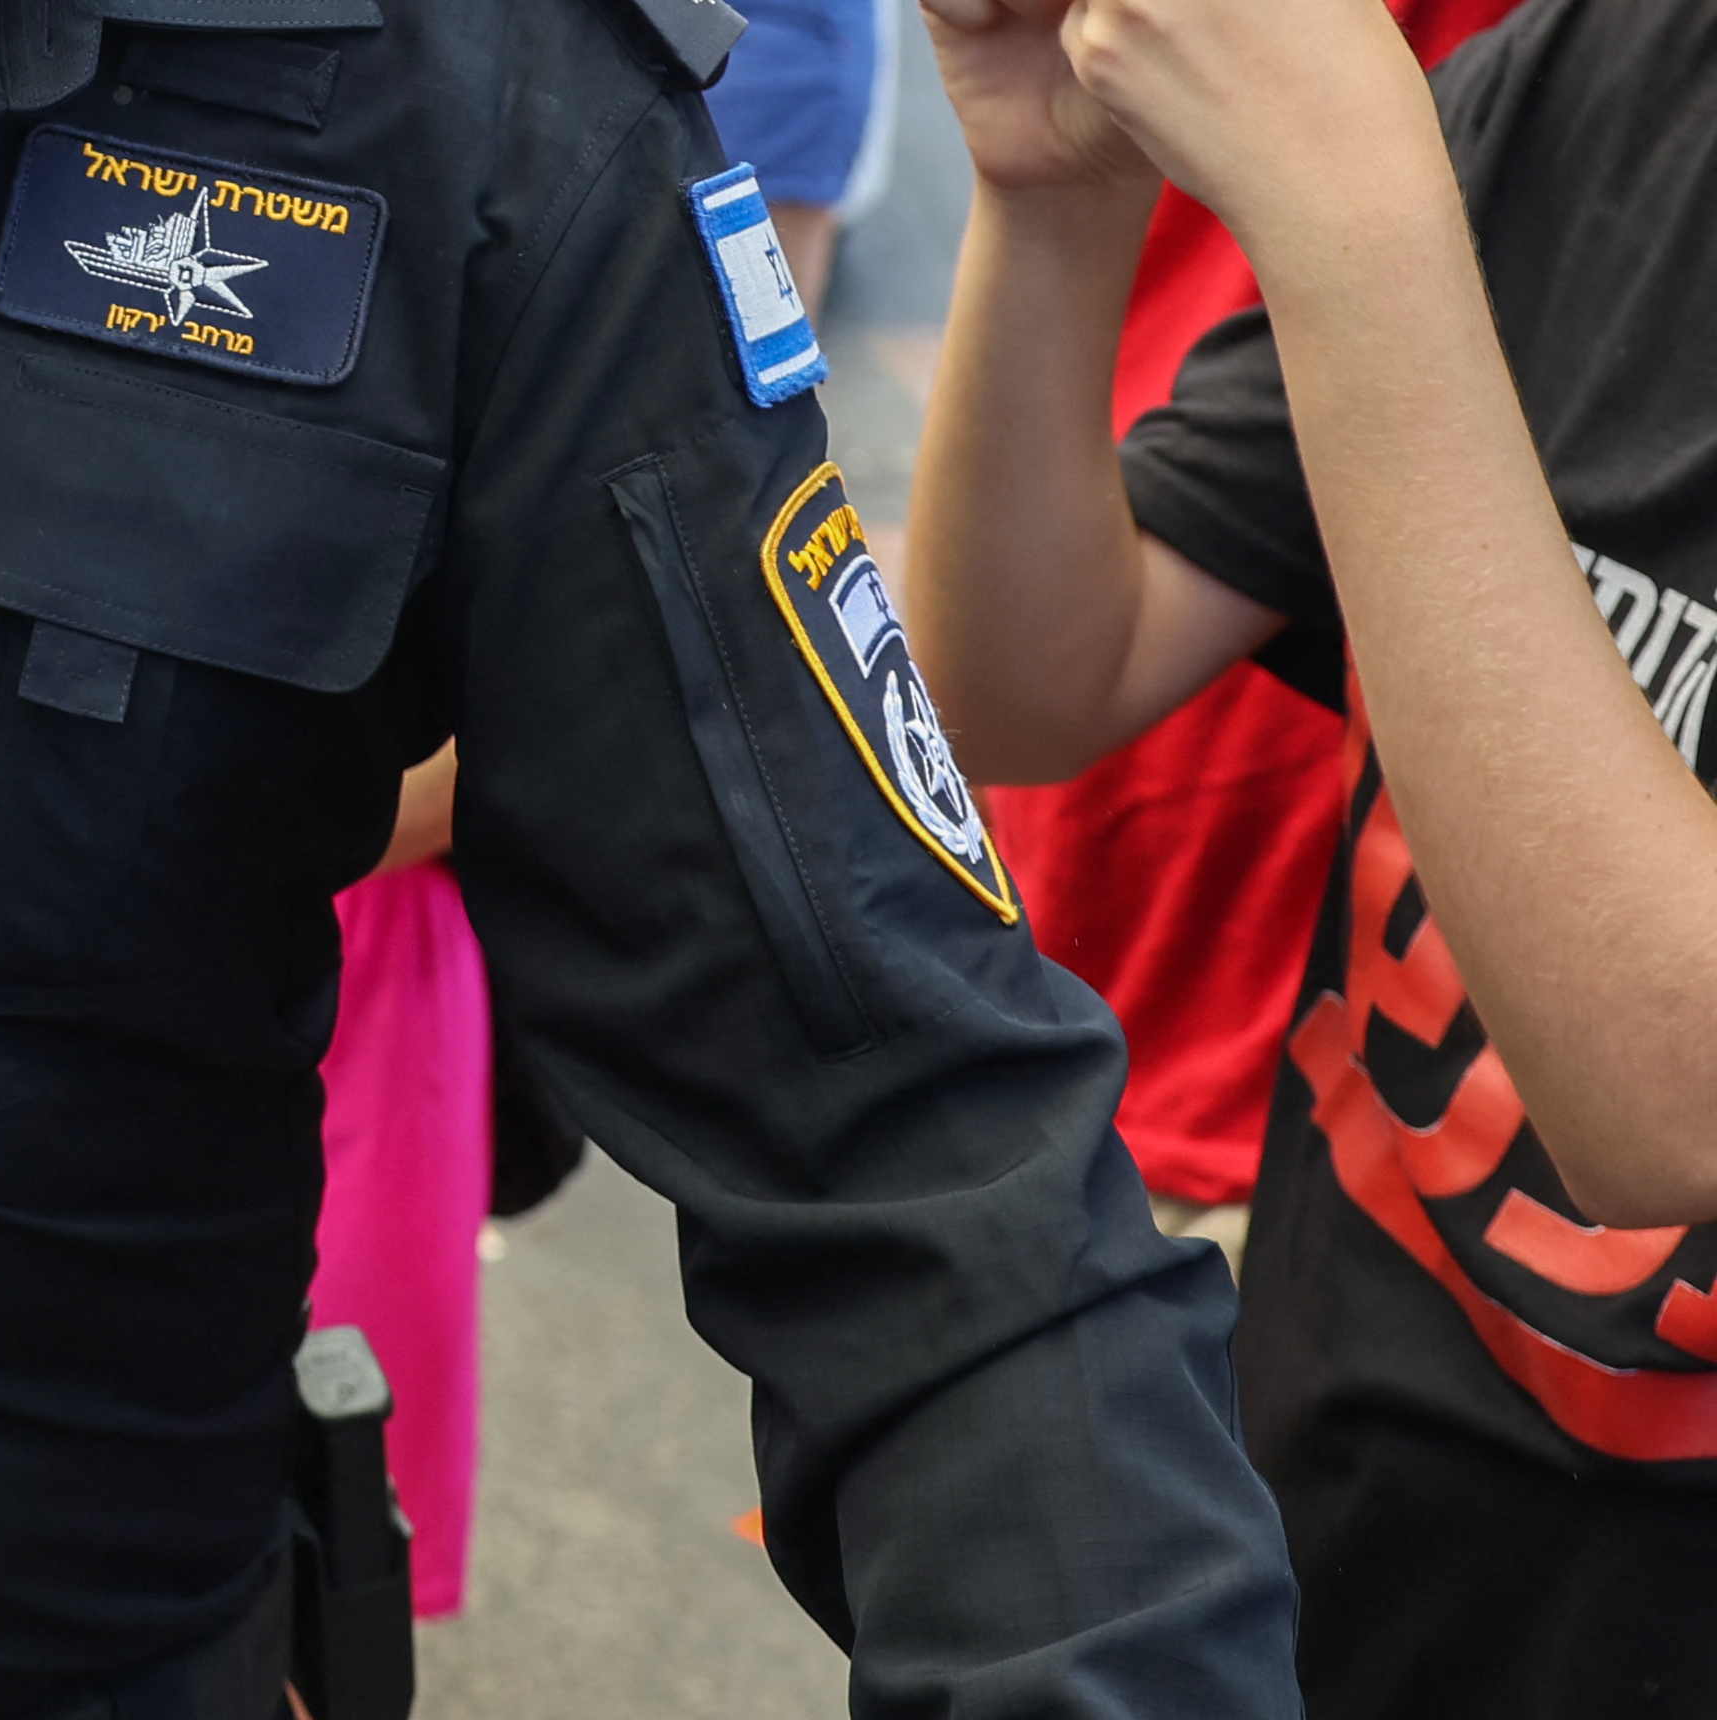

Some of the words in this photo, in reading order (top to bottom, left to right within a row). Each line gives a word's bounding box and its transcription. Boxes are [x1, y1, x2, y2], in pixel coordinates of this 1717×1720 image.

[82, 142, 197, 197] ישראל
[210, 179, 349, 235] משטרת
[106, 302, 166, 333] ירקון
[181, 321, 254, 355] מרחב
